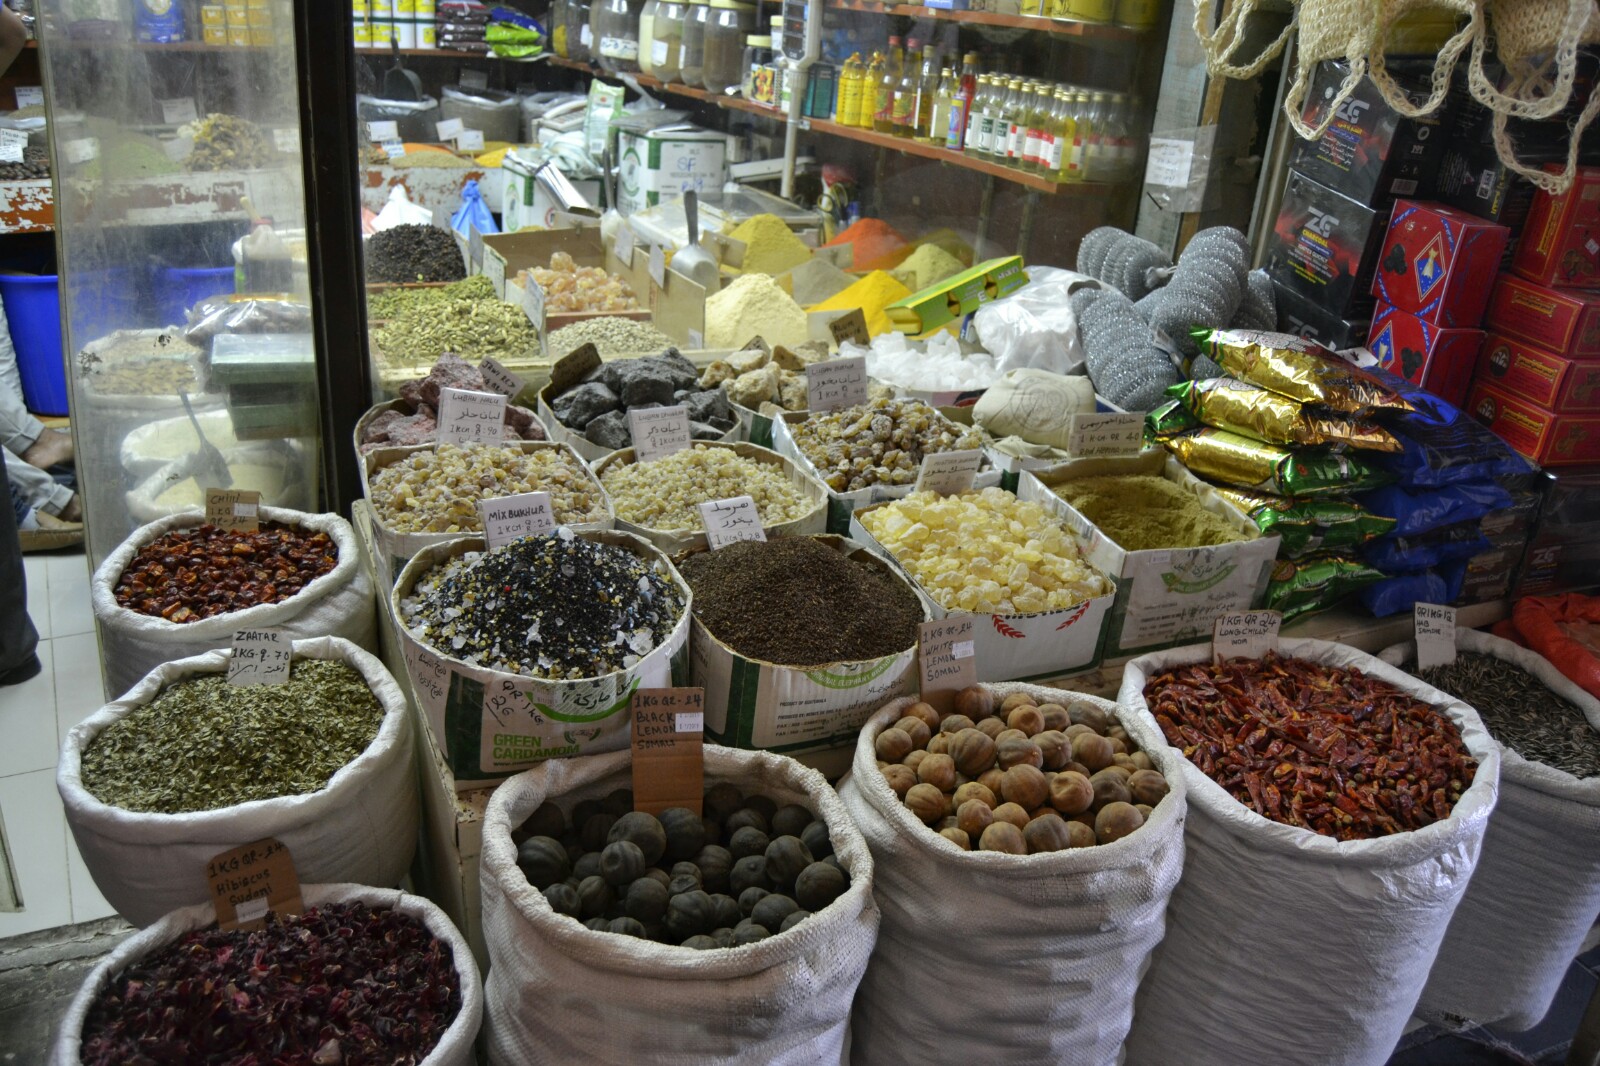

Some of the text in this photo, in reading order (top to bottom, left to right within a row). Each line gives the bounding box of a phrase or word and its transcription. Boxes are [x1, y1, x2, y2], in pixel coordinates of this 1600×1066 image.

[1304, 205, 1340, 238] ZG
[452, 393, 477, 402] LUBAN
[488, 505, 545, 521] MIX BUKHUR
[537, 519, 552, 528] 24
[1260, 613, 1277, 627] 24
[236, 631, 279, 643] ZAATAR
[1219, 628, 1241, 636] LONG
[274, 650, 290, 661] 70
[925, 641, 954, 656] WHITE
[926, 654, 956, 669] LEMON
[839, 675, 871, 687] ELEPHANT
[871, 658, 891, 678] BRAND
[927, 665, 961, 681] SOMALI
[643, 696, 658, 707] KG
[684, 694, 702, 707] 24
[636, 711, 674, 723] BLACK
[636, 723, 676, 737] LEMON
[493, 733, 541, 748] GREEN
[637, 739, 675, 749] SOMALI
[493, 744, 580, 760] CARDAMOM
[219, 857, 239, 873] KG
[216, 868, 271, 896] Hibiscus
